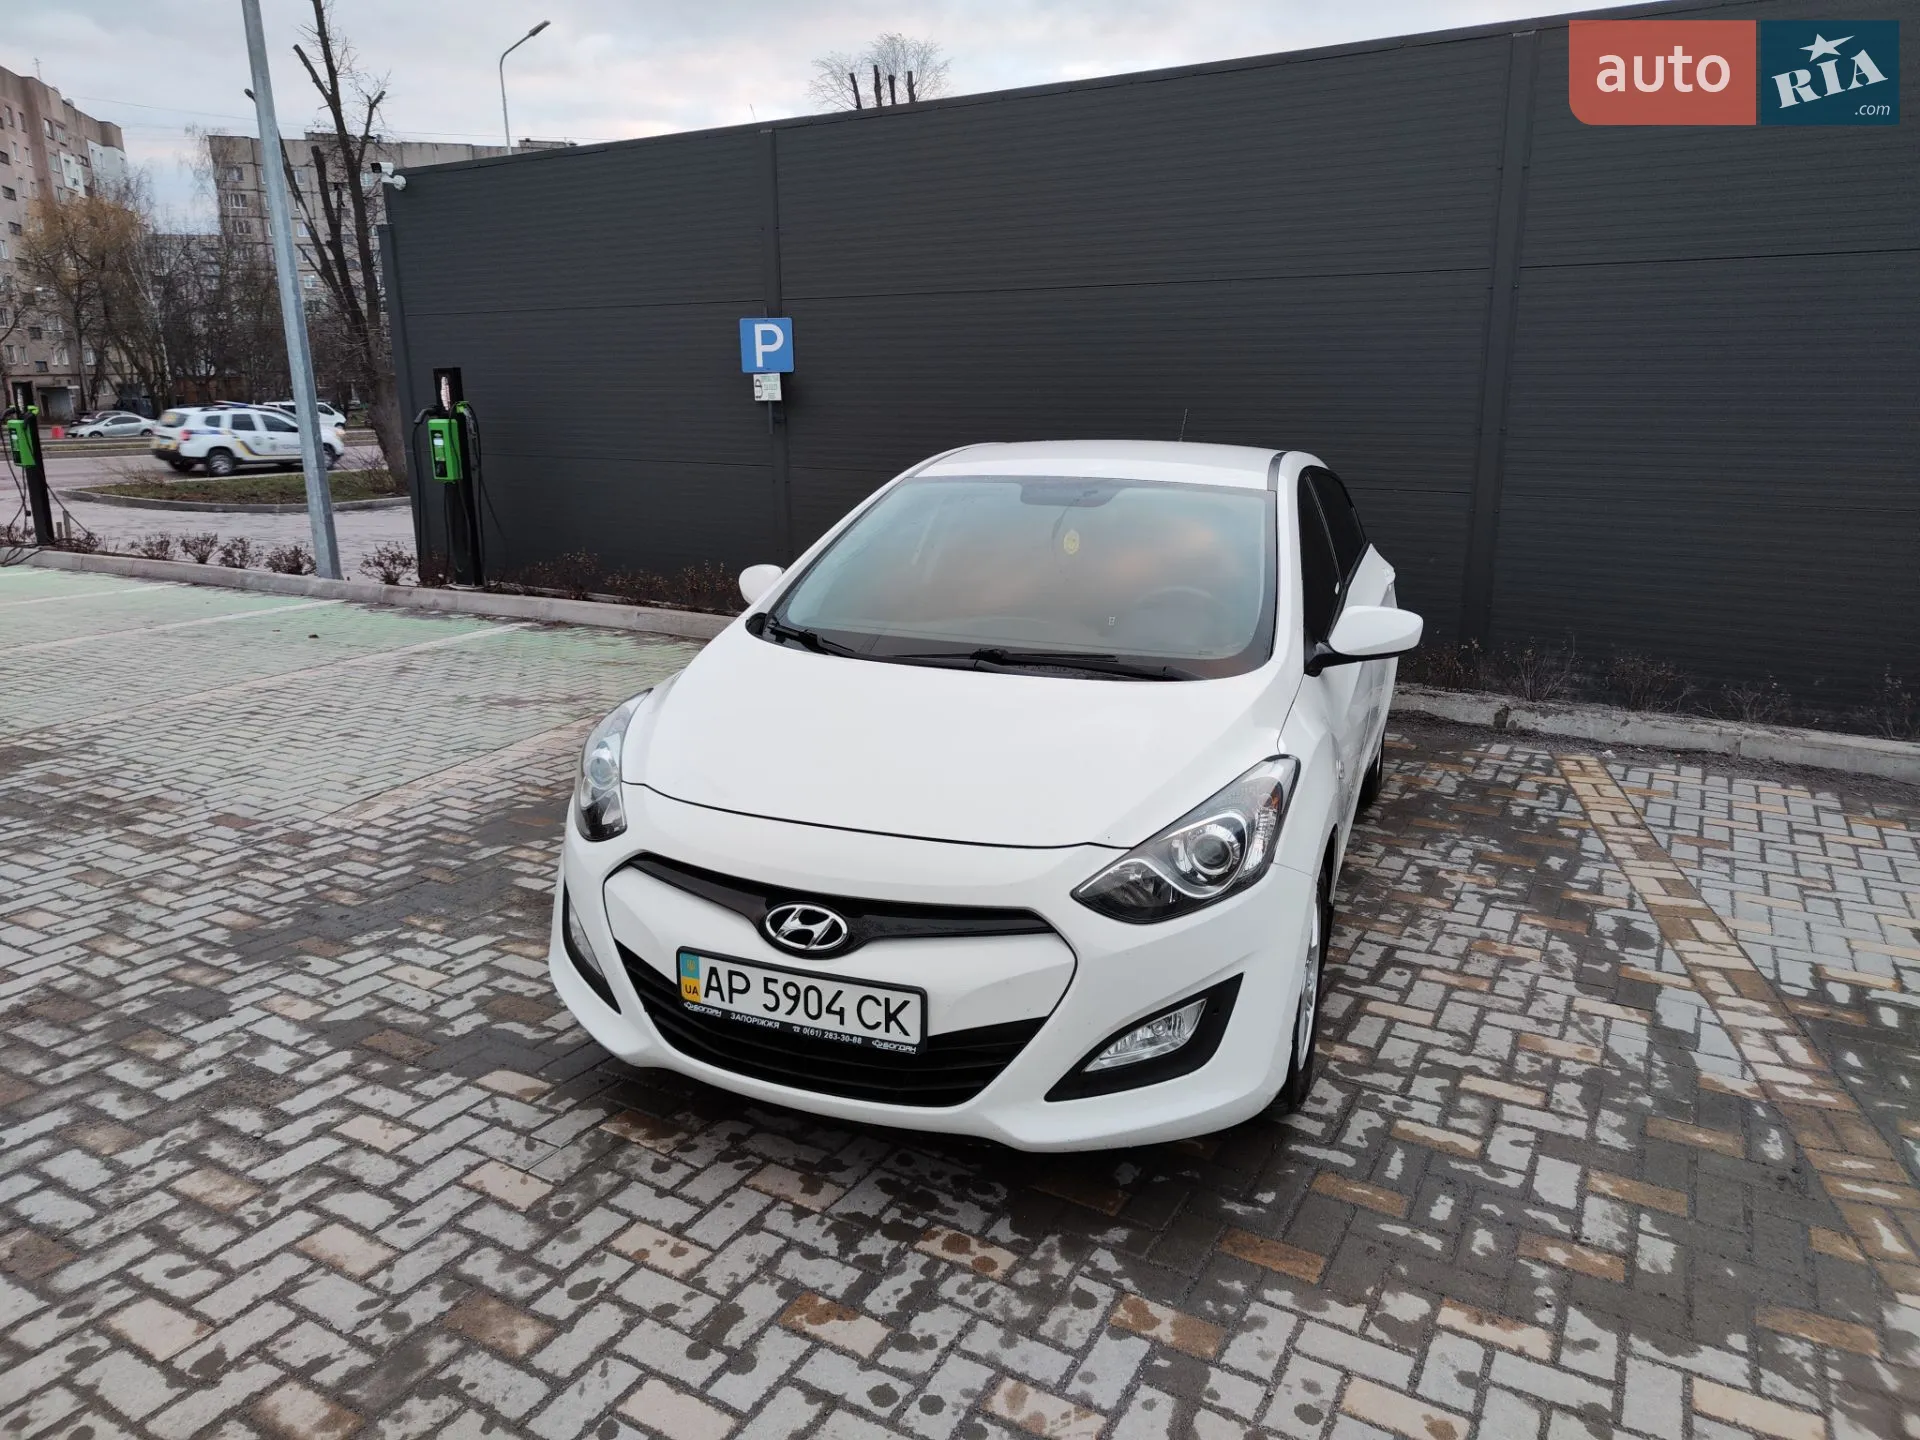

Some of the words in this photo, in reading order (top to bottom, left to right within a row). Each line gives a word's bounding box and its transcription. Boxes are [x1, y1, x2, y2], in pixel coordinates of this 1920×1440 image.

[754, 323, 784, 368] P
[684, 983, 699, 996] UA
[703, 966, 751, 1004] AP
[762, 976, 845, 1026] 5904
[856, 994, 911, 1037] CK
[730, 1012, 780, 1029] ЗАПОРІЖЖЯ
